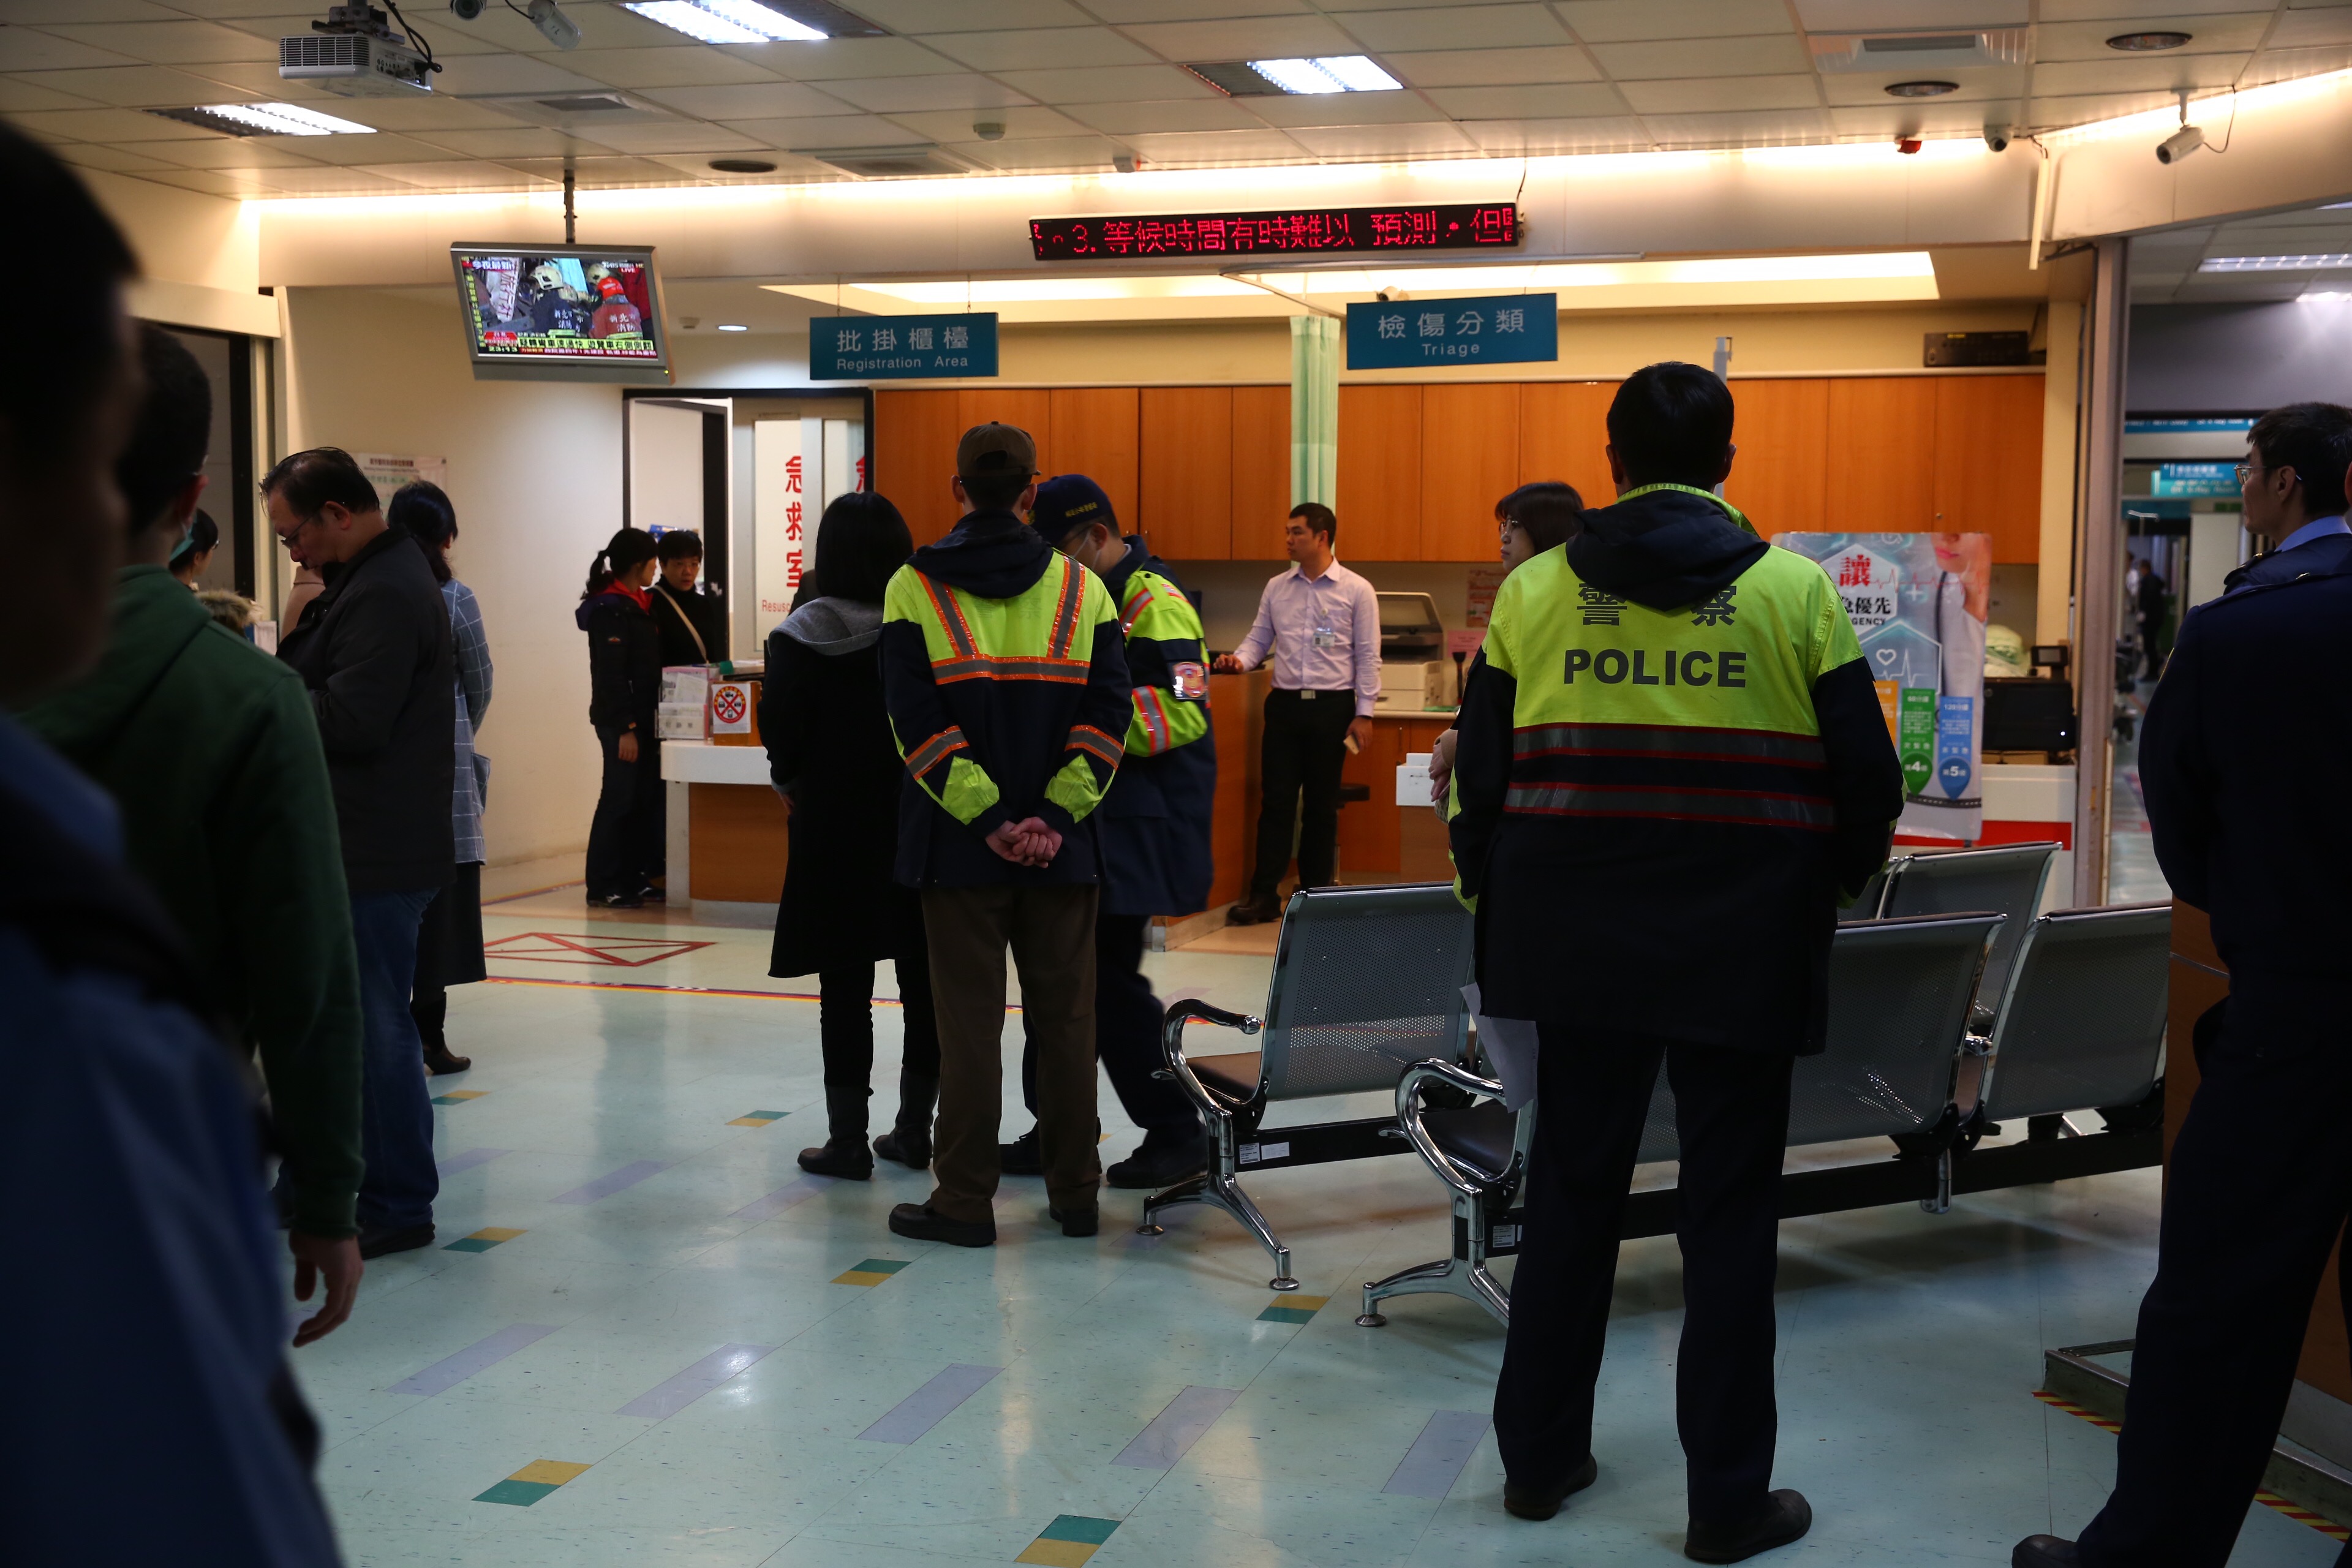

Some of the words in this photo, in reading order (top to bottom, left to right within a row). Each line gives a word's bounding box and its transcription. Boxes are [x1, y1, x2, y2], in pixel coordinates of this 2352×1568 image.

[1378, 309, 1525, 339] 檢傷分類
[837, 326, 968, 352] 批掛櫃檯
[1422, 343, 1480, 357] Triage
[837, 356, 921, 372] Registration
[935, 356, 968, 368] Area
[1839, 554, 1871, 587] 讓
[1564, 649, 1746, 688] POLICE
